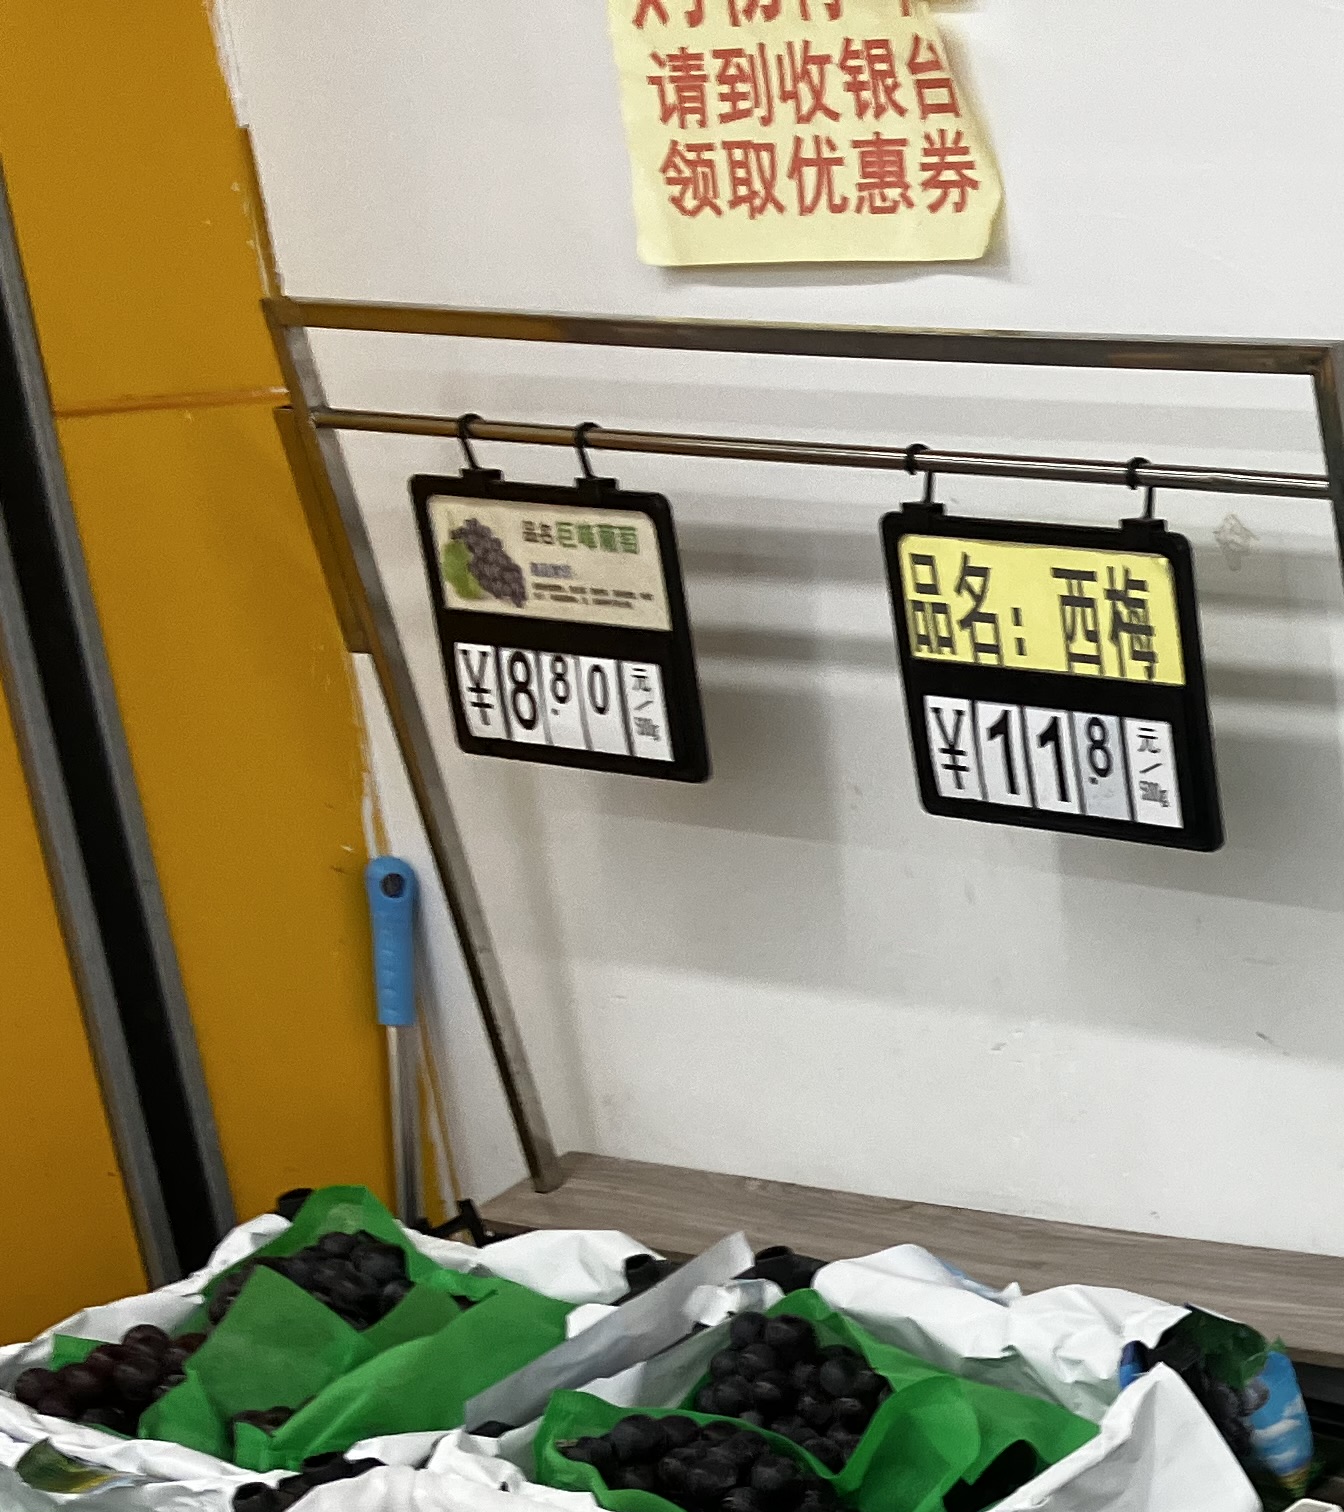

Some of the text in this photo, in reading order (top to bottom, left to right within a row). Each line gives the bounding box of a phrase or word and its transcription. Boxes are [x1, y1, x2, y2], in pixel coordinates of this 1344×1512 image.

[647, 34, 963, 129] 请到收银台
[659, 129, 981, 219] 领取优惠券
